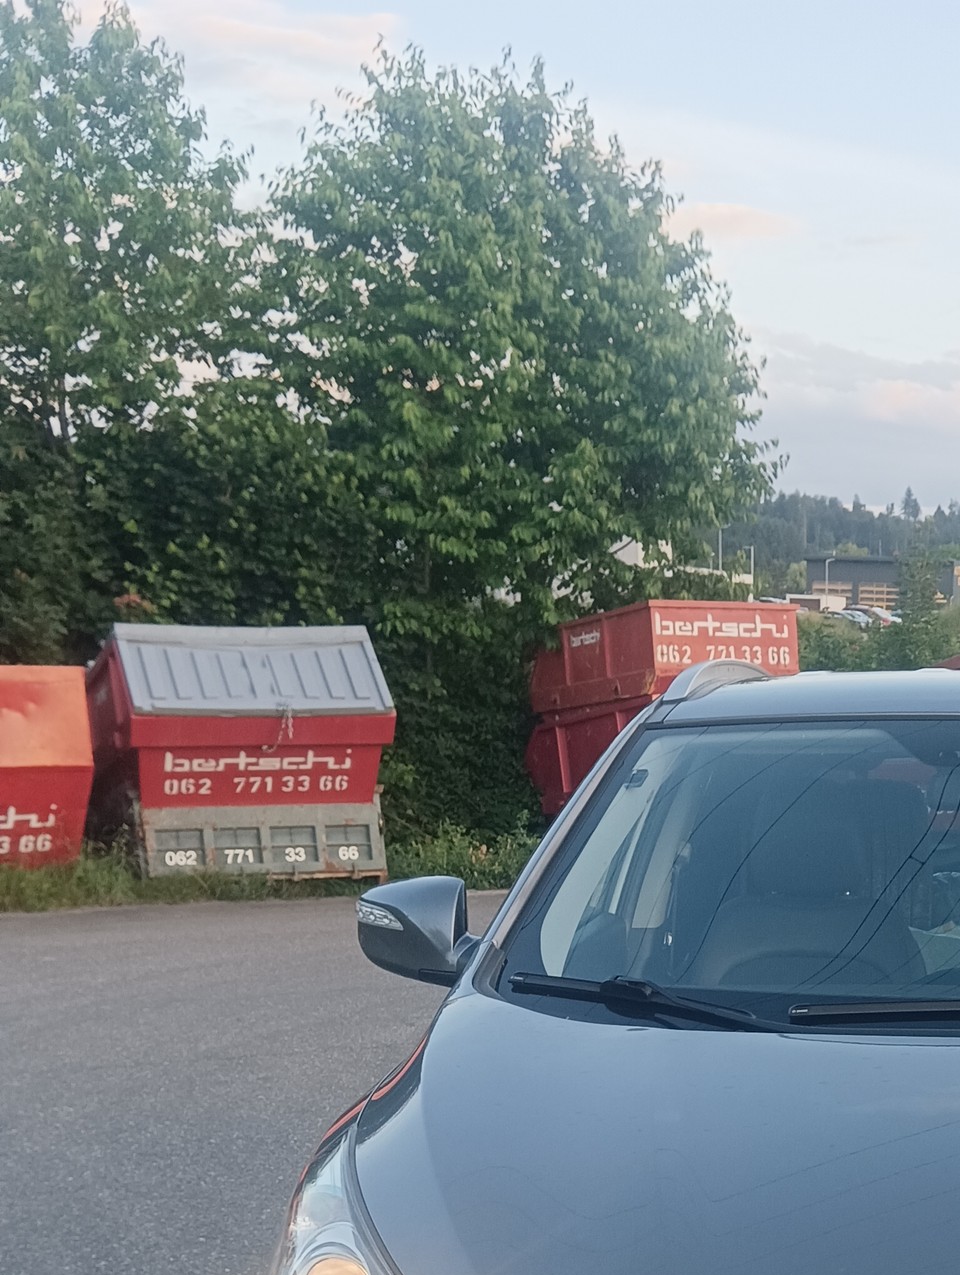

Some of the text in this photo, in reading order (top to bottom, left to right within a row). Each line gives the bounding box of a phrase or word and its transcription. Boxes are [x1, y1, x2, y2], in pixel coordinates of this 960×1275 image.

[655, 611, 789, 638] bertschi
[656, 644, 790, 665] 062 771 33 66
[164, 748, 352, 772] bertschi
[164, 775, 349, 795] 062 771 33 66
[18, 833, 53, 854] 66
[165, 845, 360, 866] 062 771 33 66
